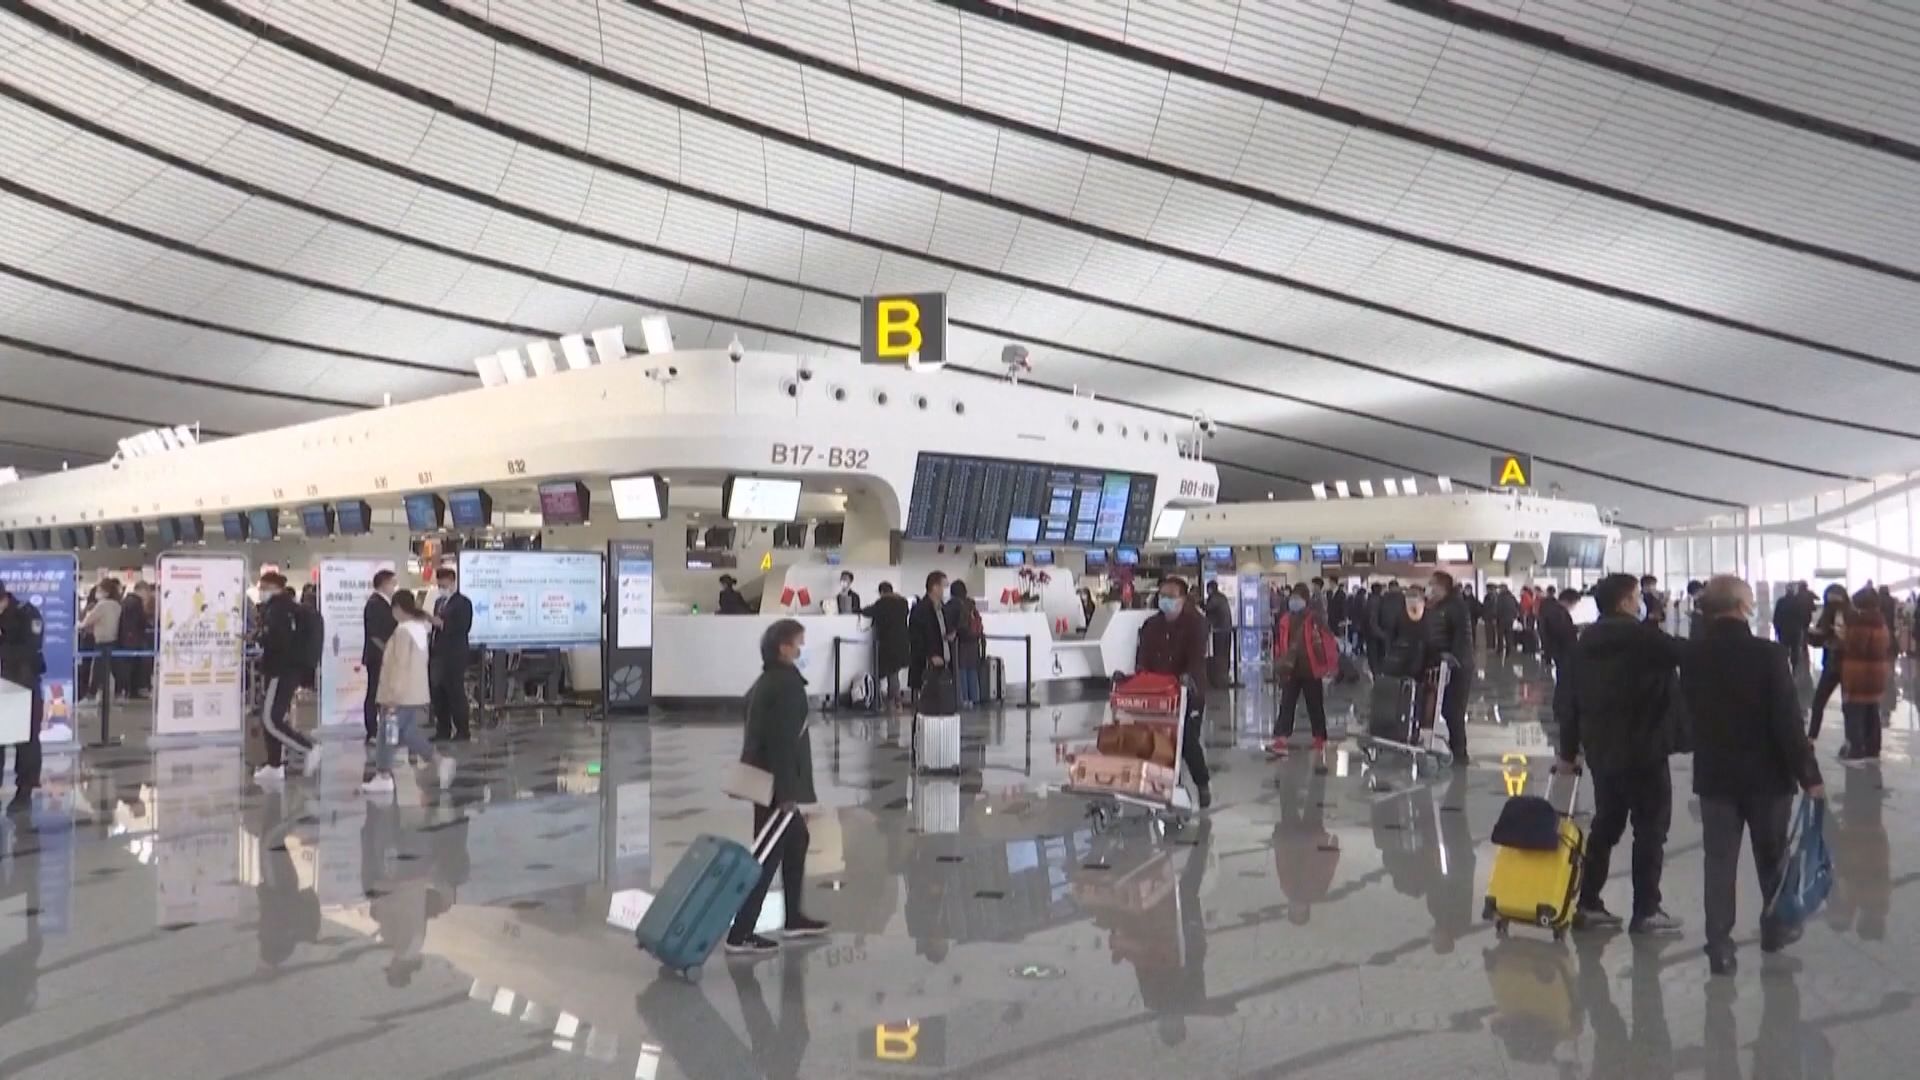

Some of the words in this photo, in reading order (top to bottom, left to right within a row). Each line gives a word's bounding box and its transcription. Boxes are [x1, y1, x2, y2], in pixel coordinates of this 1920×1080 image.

[877, 299, 922, 357] B
[507, 458, 527, 475] B32
[1500, 457, 1526, 485] A
